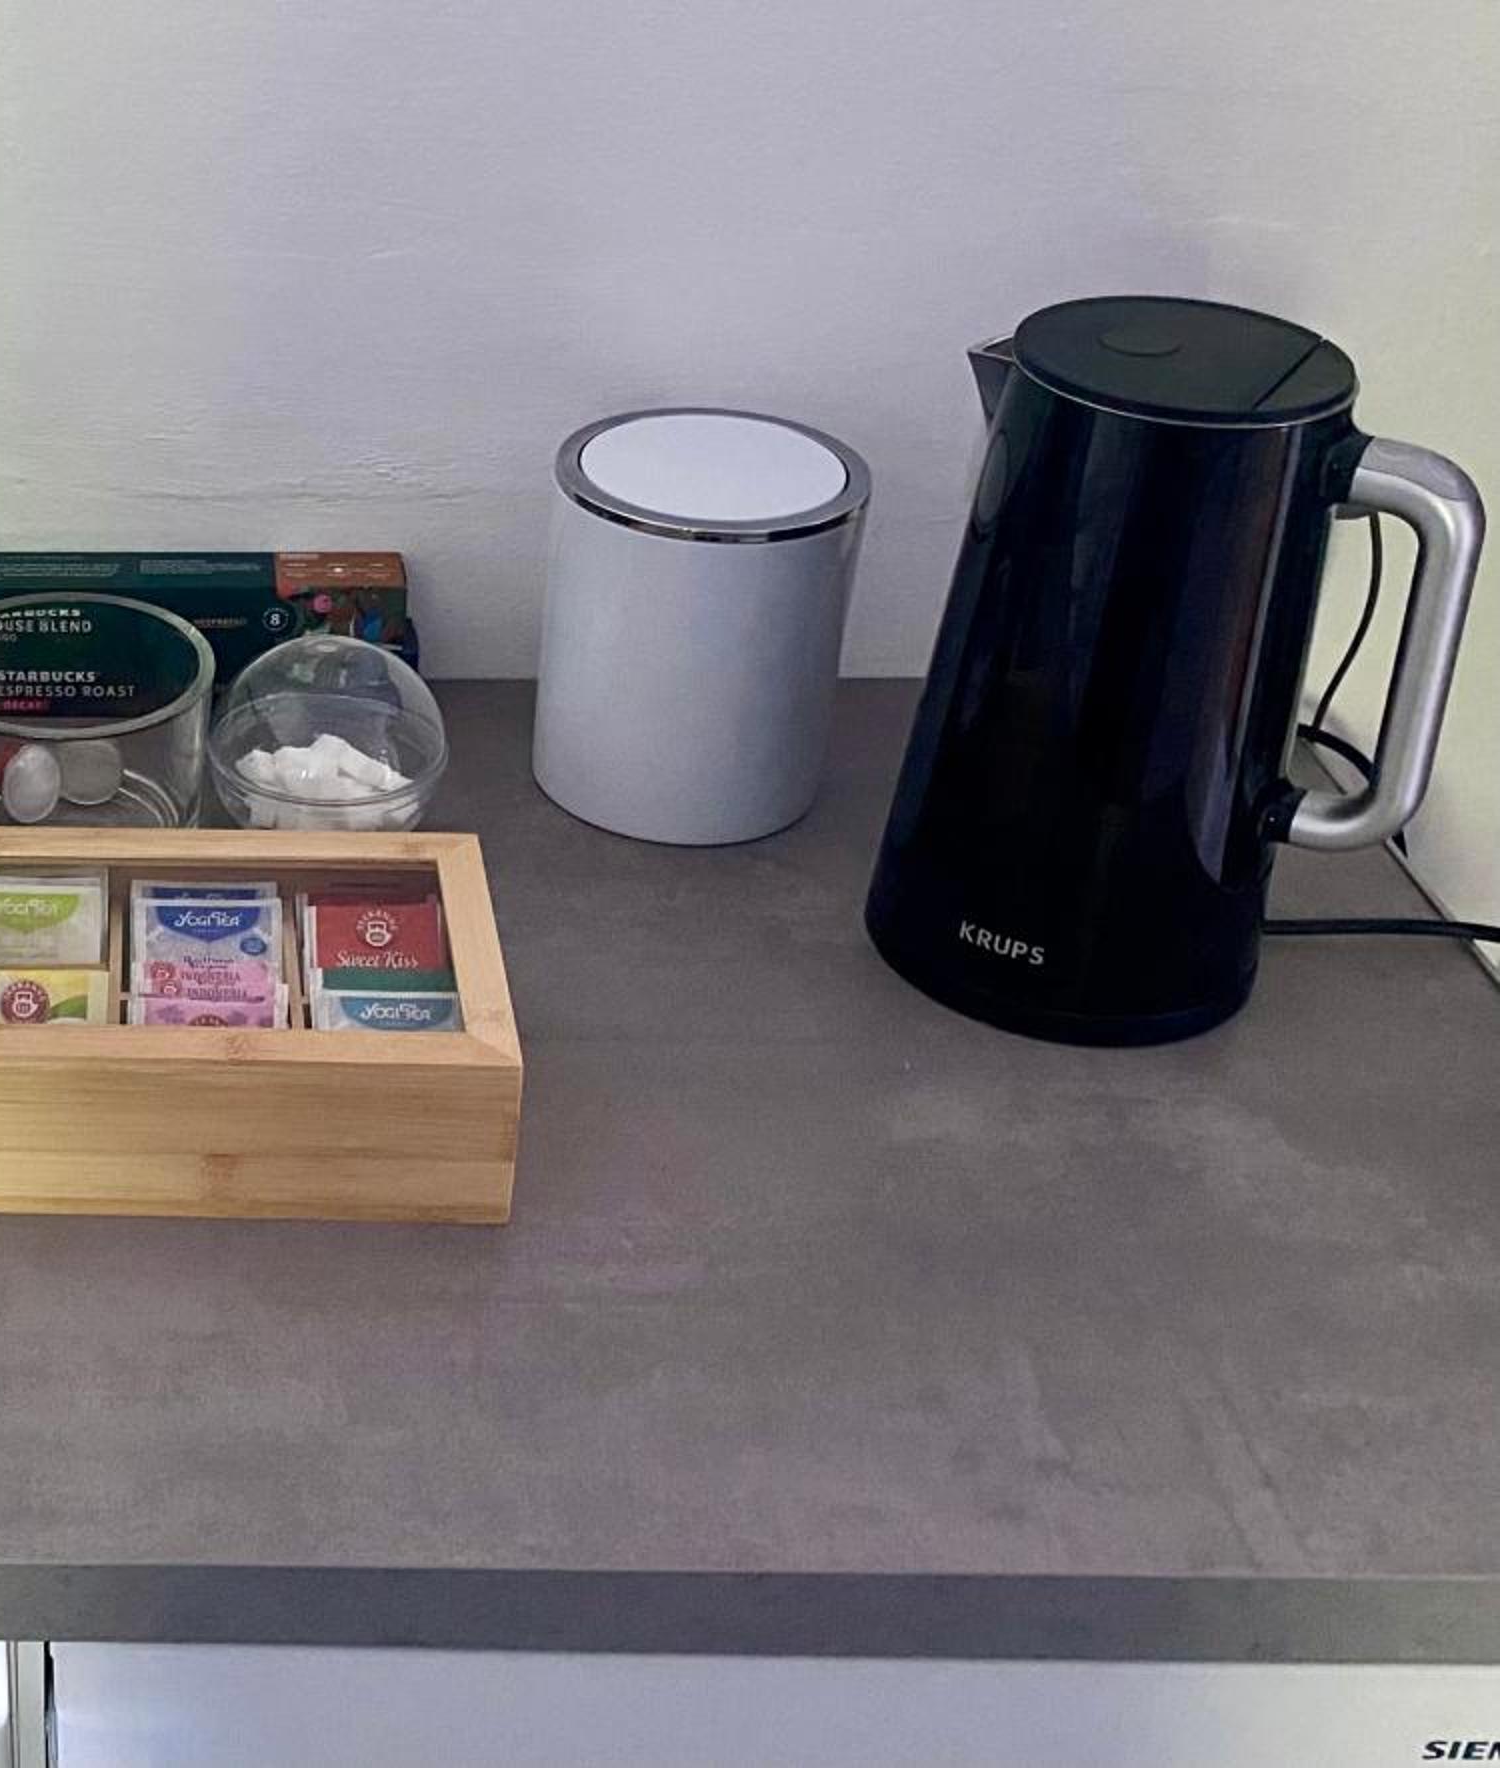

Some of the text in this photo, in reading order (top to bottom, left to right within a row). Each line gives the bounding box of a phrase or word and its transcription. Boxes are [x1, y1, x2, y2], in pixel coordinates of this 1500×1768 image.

[269, 613, 282, 626] 8
[38, 620, 93, 634] BLEND
[82, 685, 136, 697] ROAST
[959, 920, 1045, 965] KRUPS
[335, 950, 419, 969] Sweet Kiss
